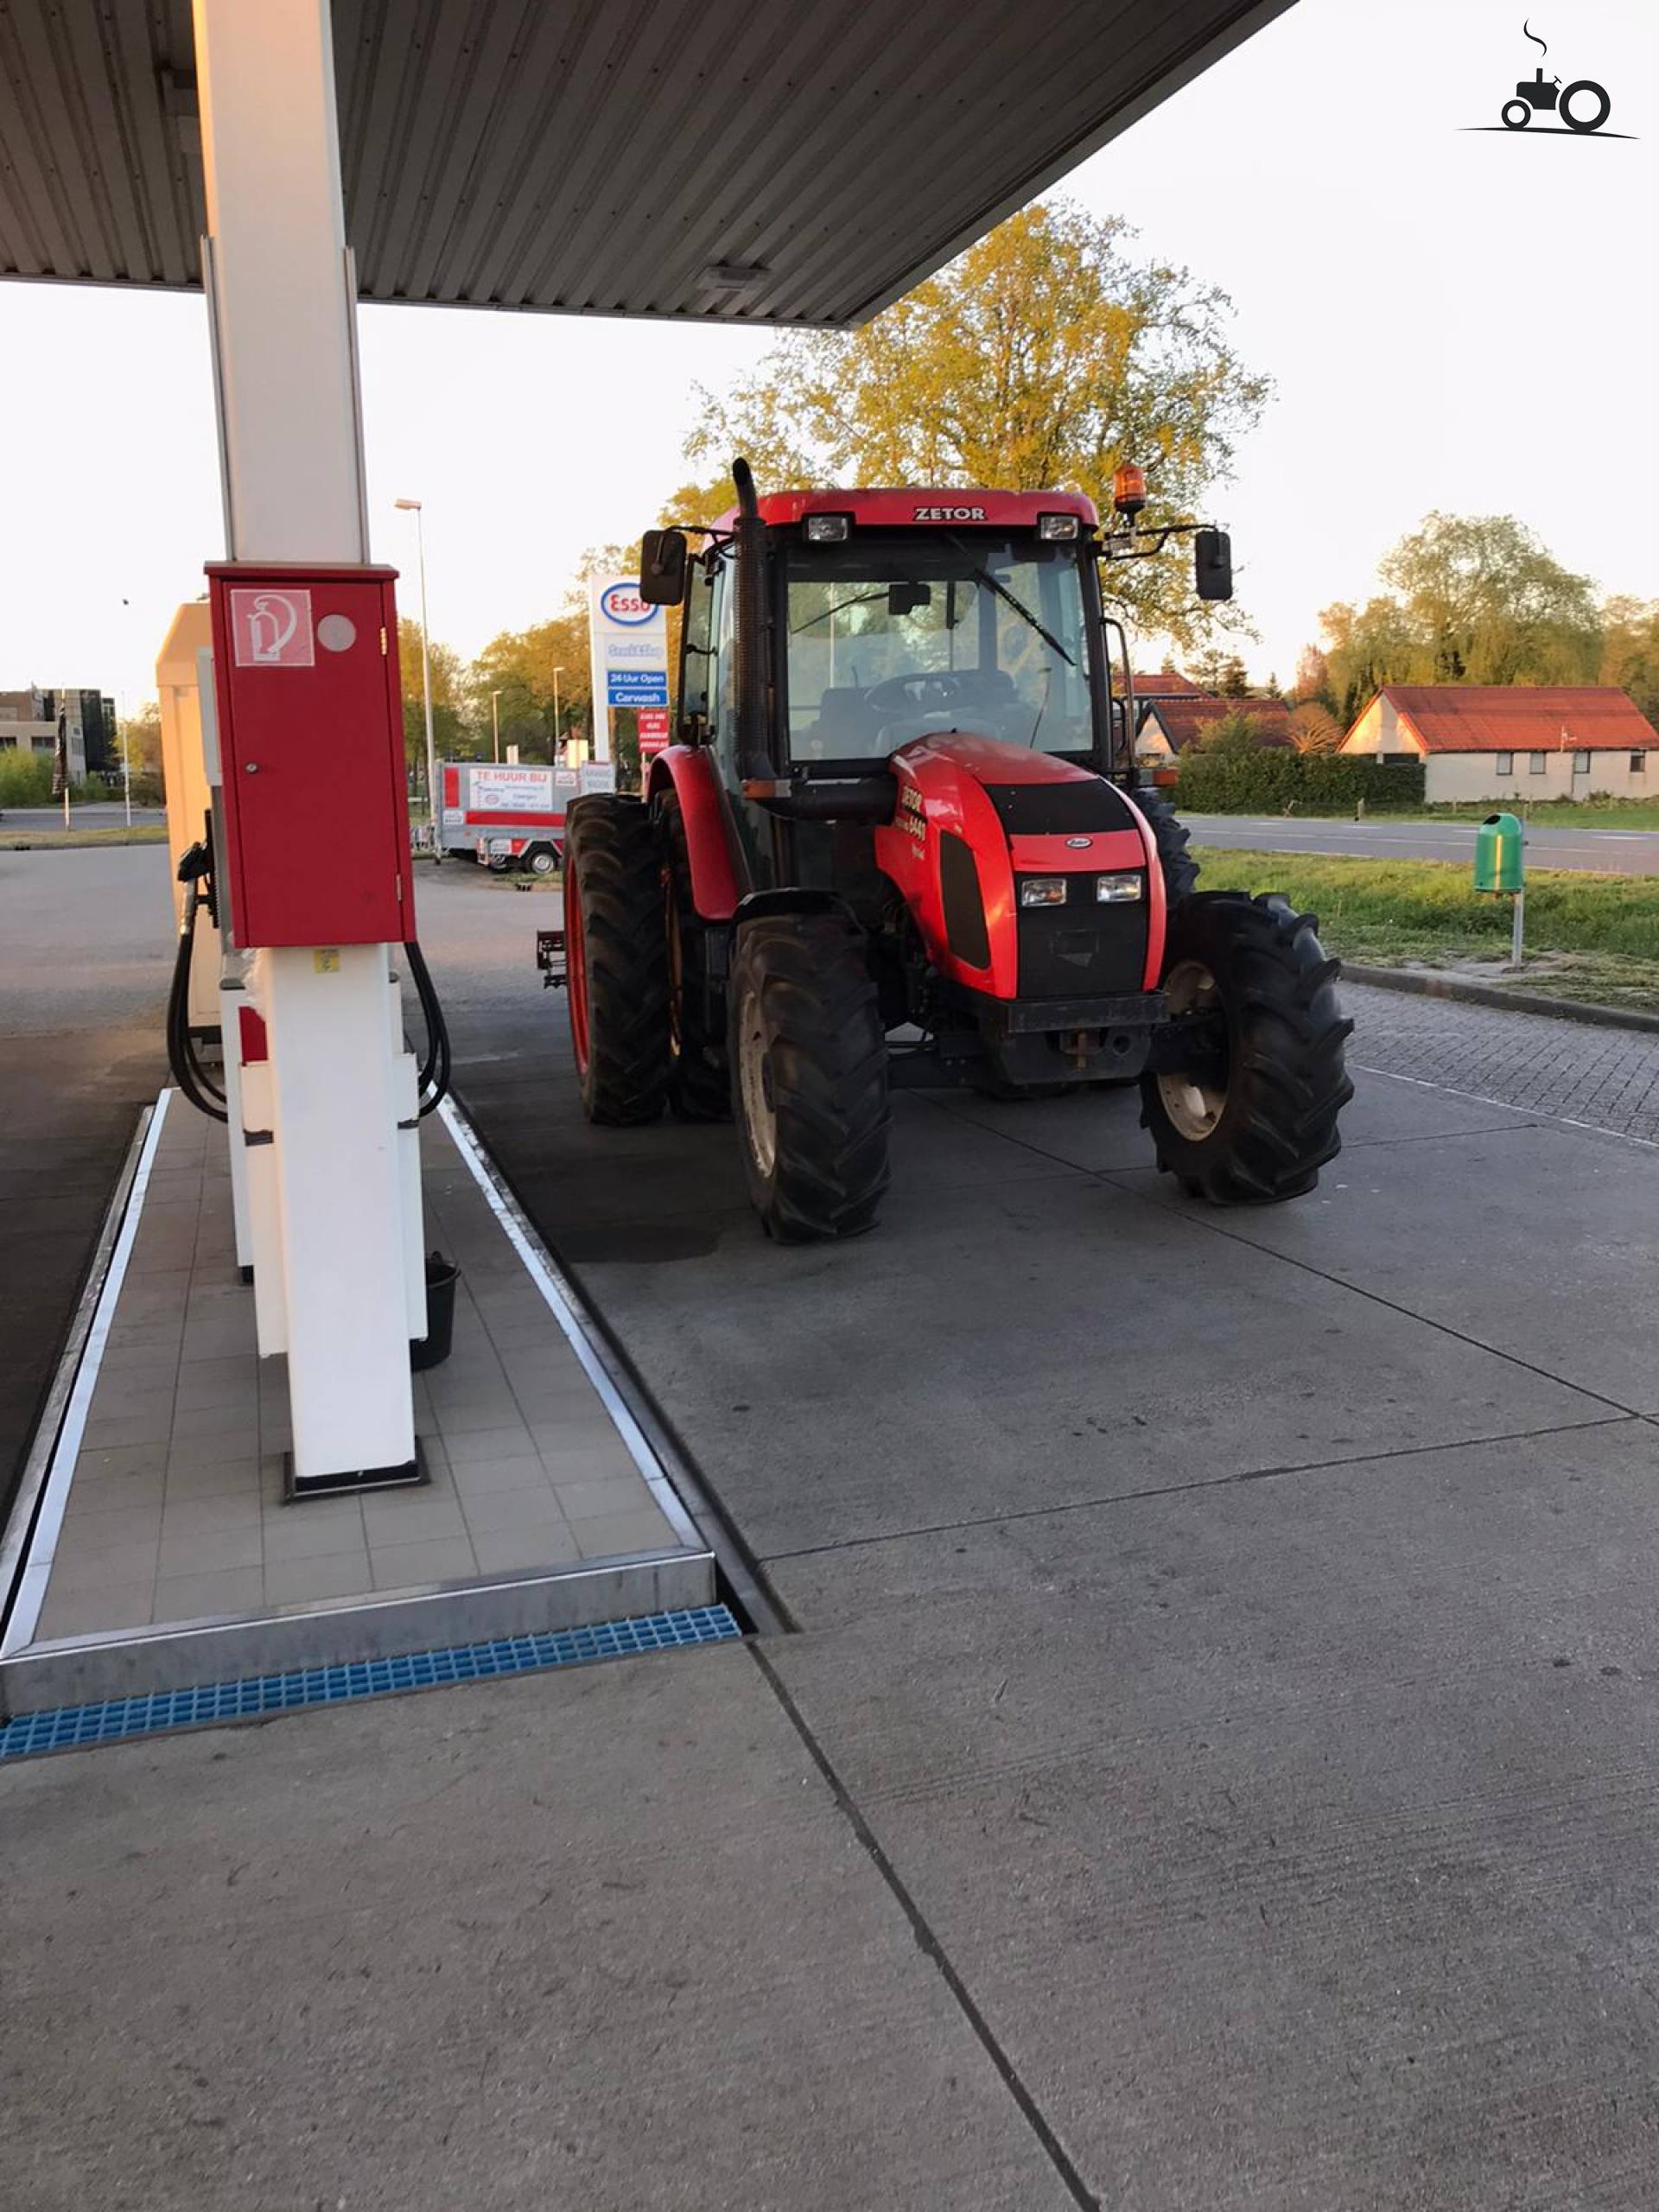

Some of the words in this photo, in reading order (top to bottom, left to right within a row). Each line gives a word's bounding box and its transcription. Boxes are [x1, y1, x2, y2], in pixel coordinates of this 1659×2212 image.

[914, 507, 987, 521] ZETOR
[610, 594, 651, 613] Esso
[640, 673, 664, 684] Open
[614, 691, 661, 703] Carwash
[476, 771, 488, 781] TE
[494, 772, 526, 782] HUUR
